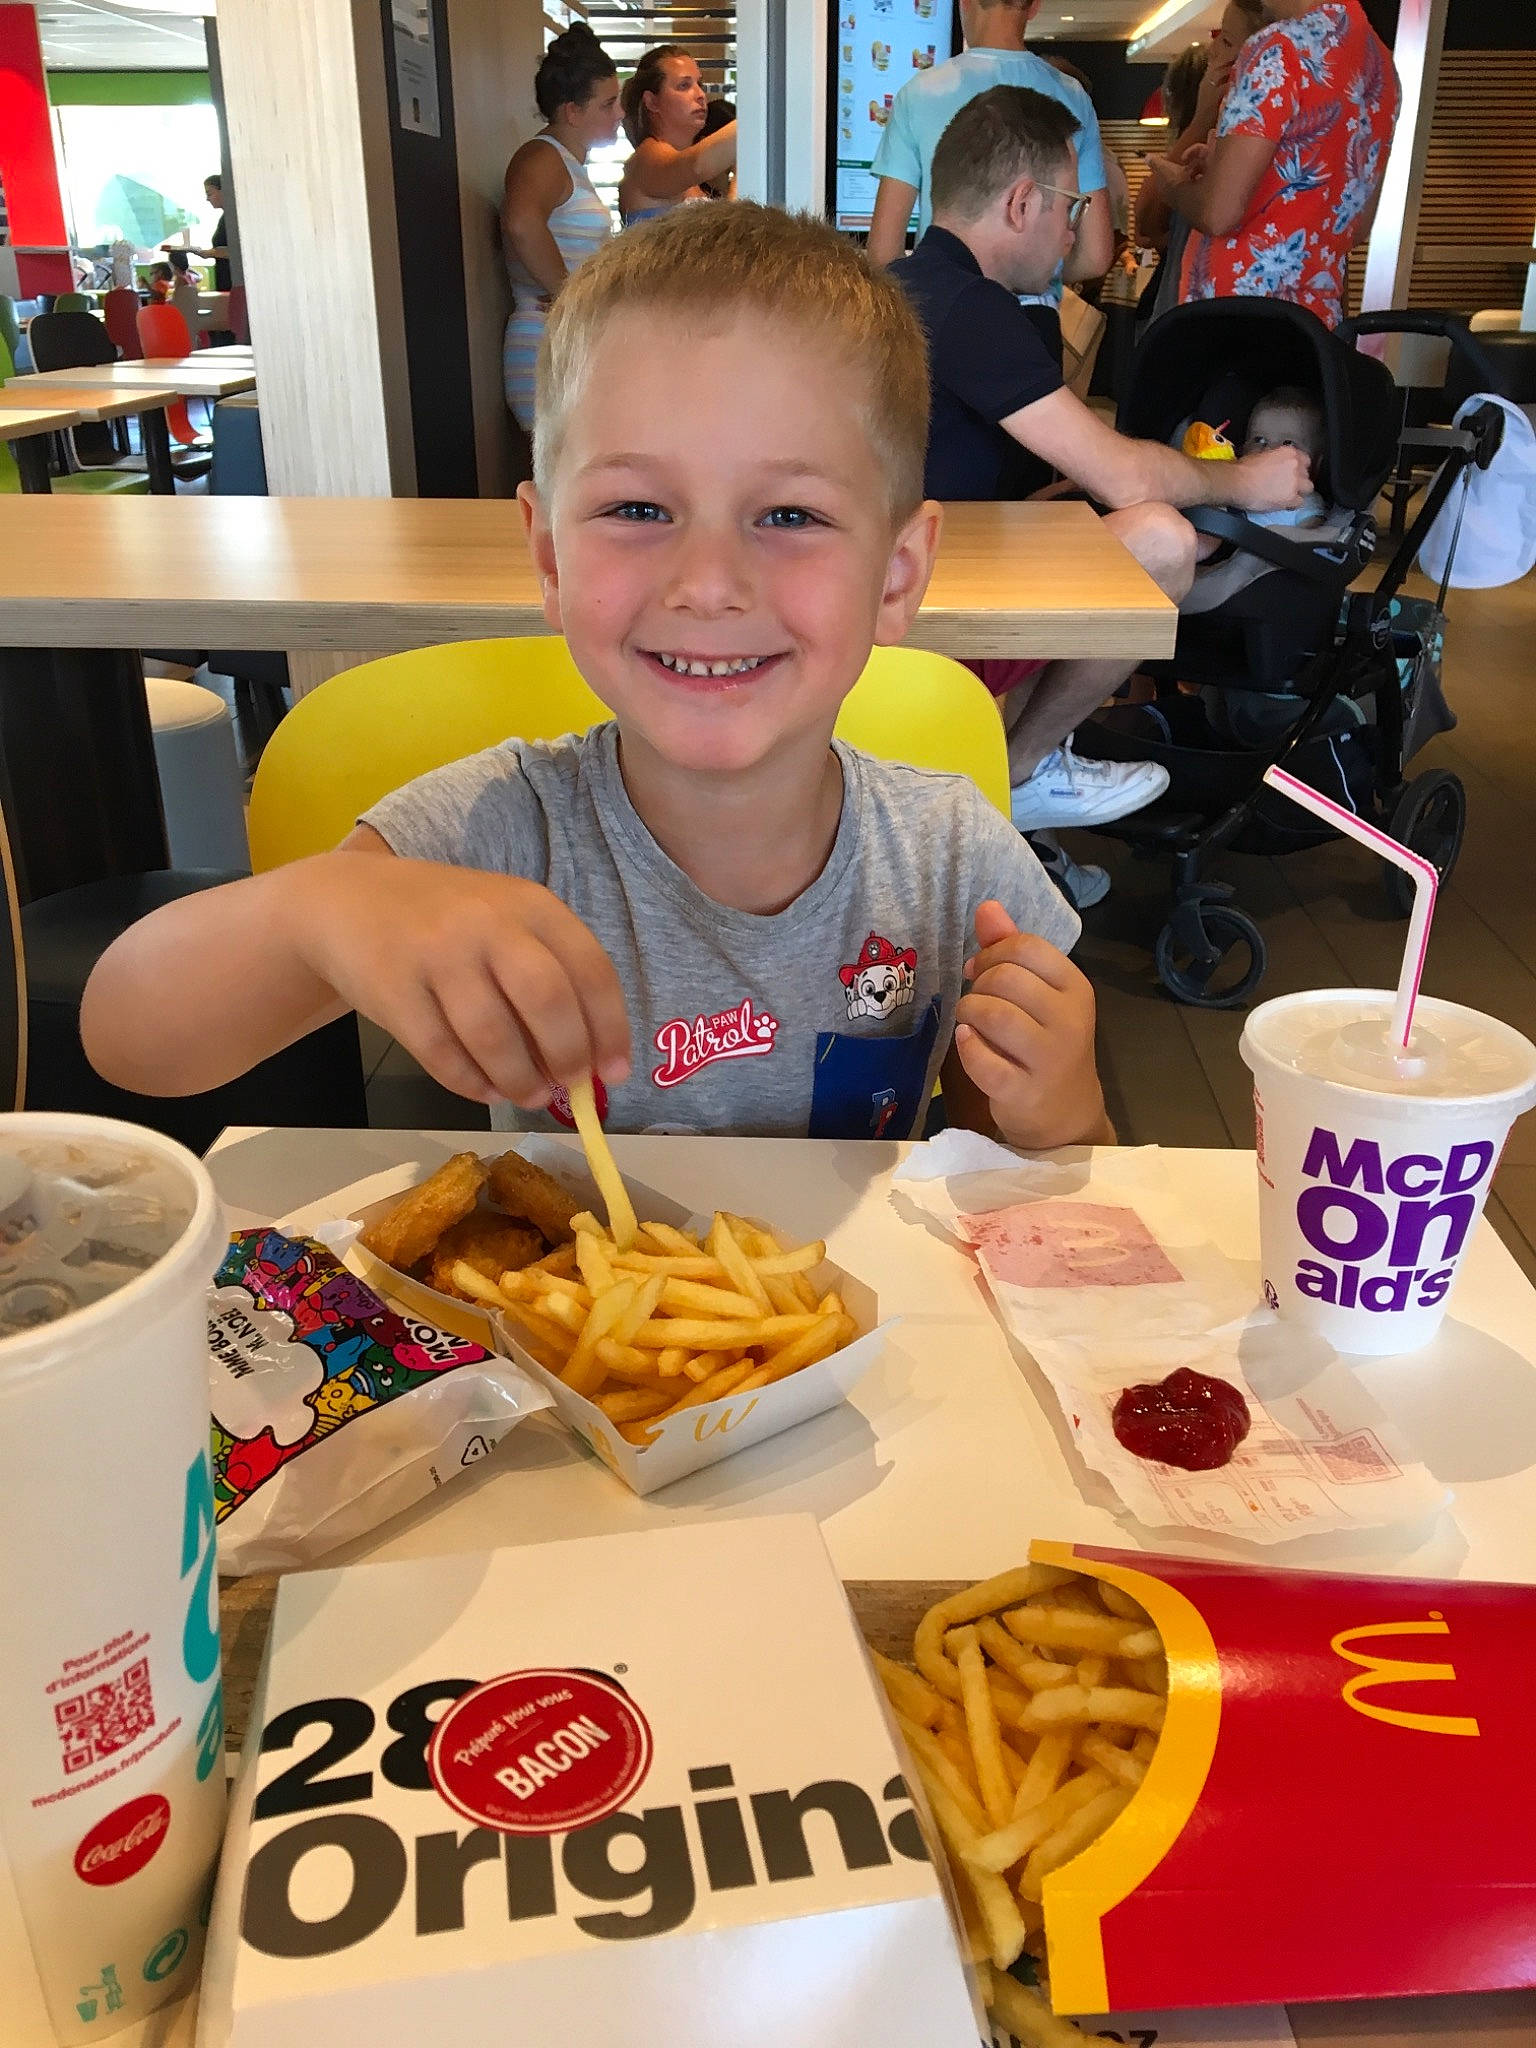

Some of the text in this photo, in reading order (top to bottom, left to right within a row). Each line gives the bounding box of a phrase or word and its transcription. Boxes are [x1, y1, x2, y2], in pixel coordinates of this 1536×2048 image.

[657, 1001, 757, 1075] Patrol
[712, 1011, 738, 1029] PAW
[1301, 1126, 1494, 1197] McD
[1295, 1259, 1453, 1312] ald's
[63, 1629, 134, 1672] Pour plus
[503, 1702, 536, 1730] pour
[535, 1688, 574, 1709] vous
[494, 1713, 611, 1801] BACON
